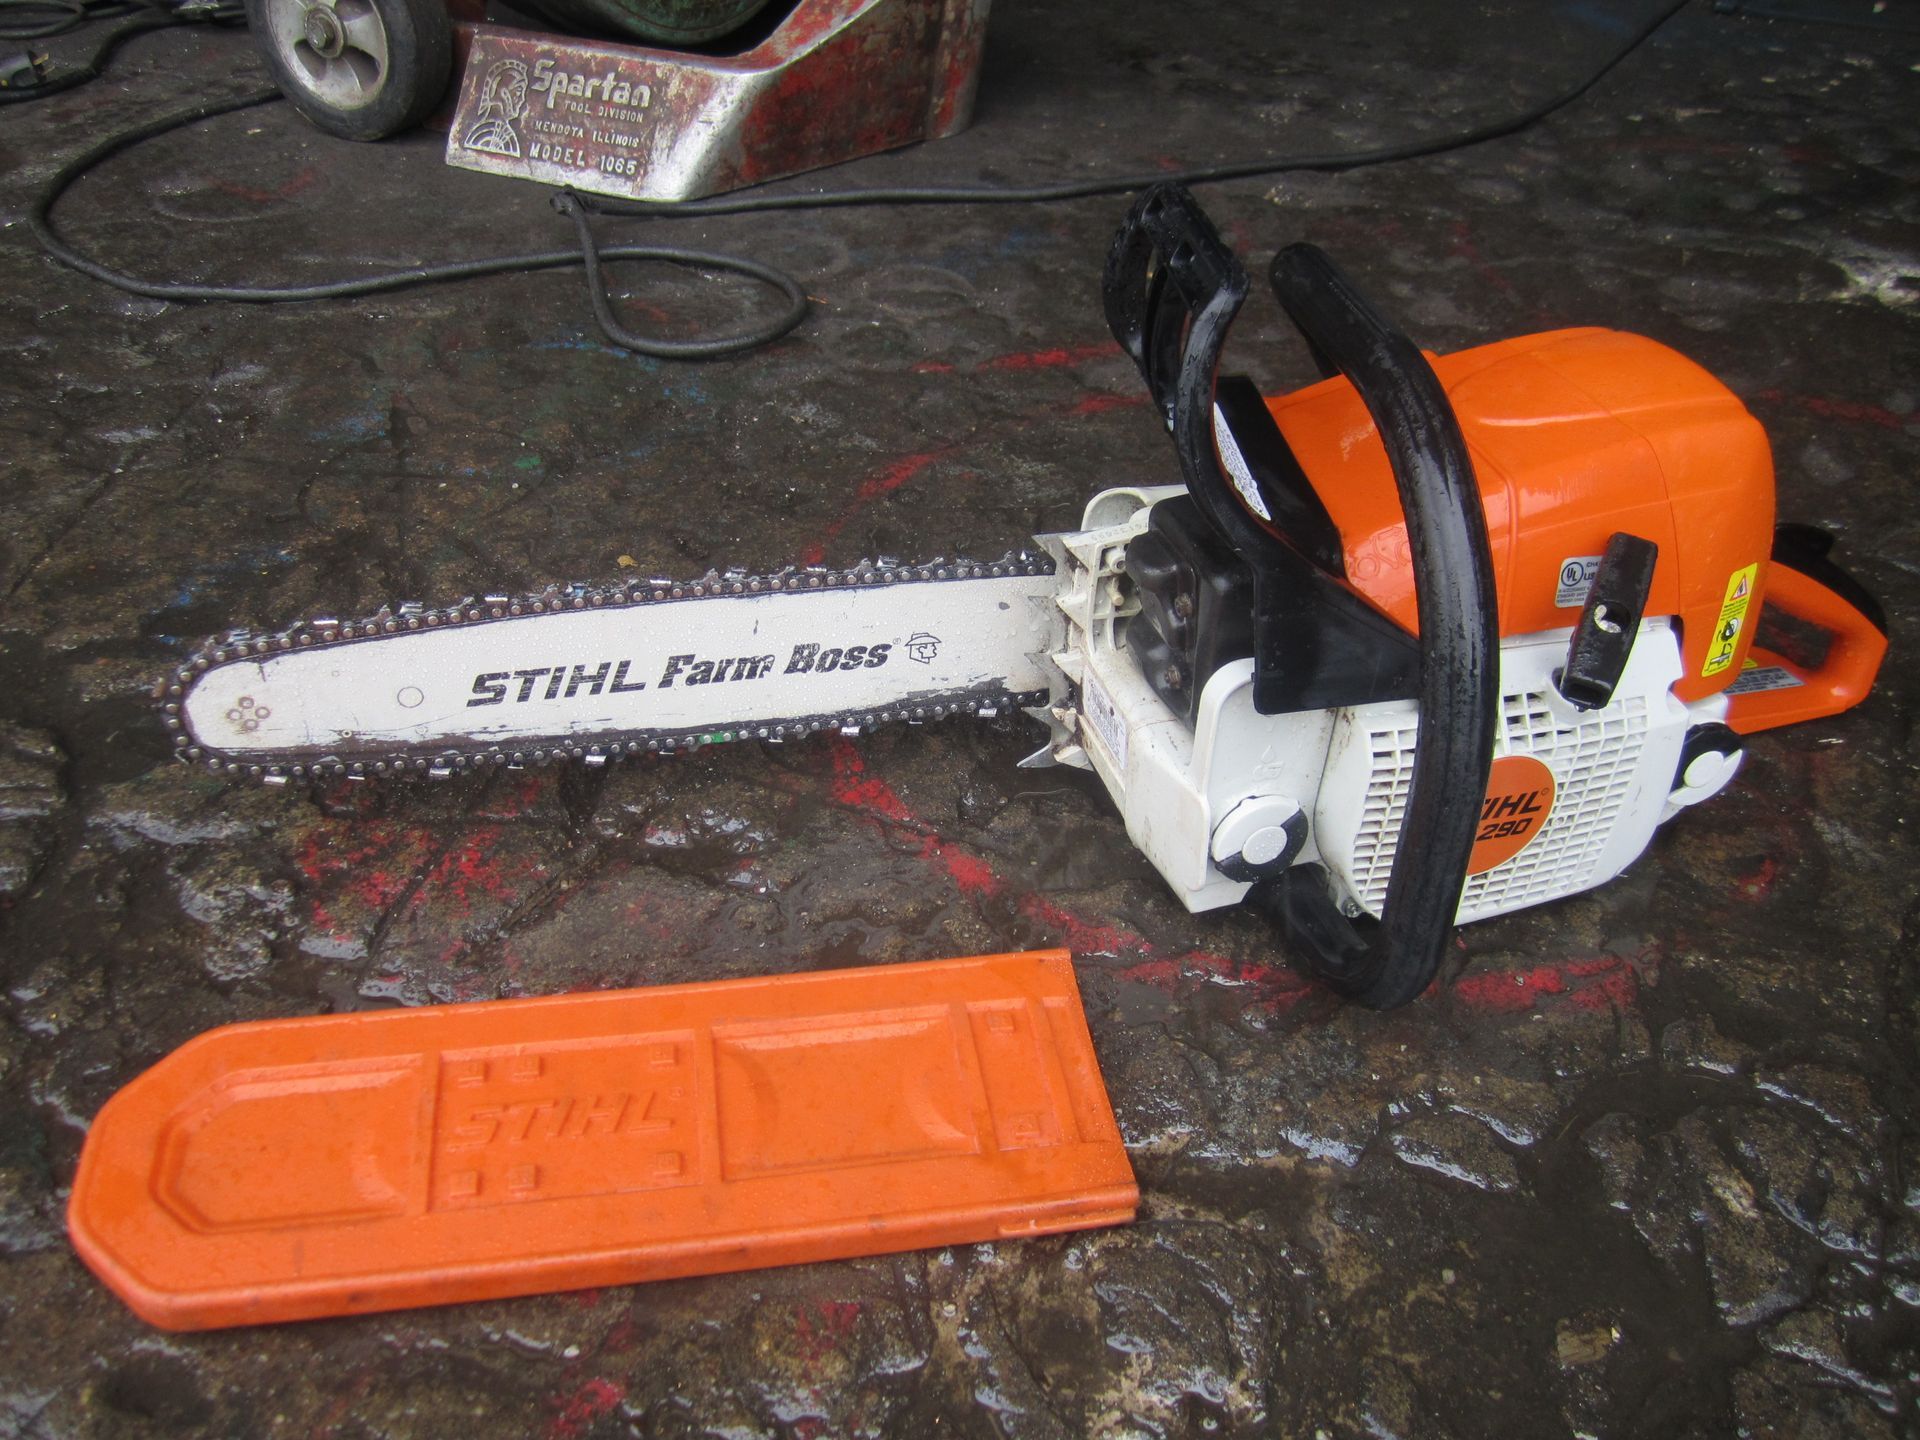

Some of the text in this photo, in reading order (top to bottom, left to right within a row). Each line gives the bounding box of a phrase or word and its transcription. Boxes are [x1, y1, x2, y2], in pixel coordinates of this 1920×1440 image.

[531, 59, 651, 109] Spartan
[564, 100, 644, 124] TOOL DIVISION
[534, 120, 640, 148] MENDOTA ILLINOIS
[529, 142, 638, 175] MODEL 1065
[466, 642, 892, 708] STIHL Farm Boss
[1480, 791, 1542, 821] IHL
[1475, 817, 1534, 842] 290
[446, 1090, 676, 1152] STIHL
